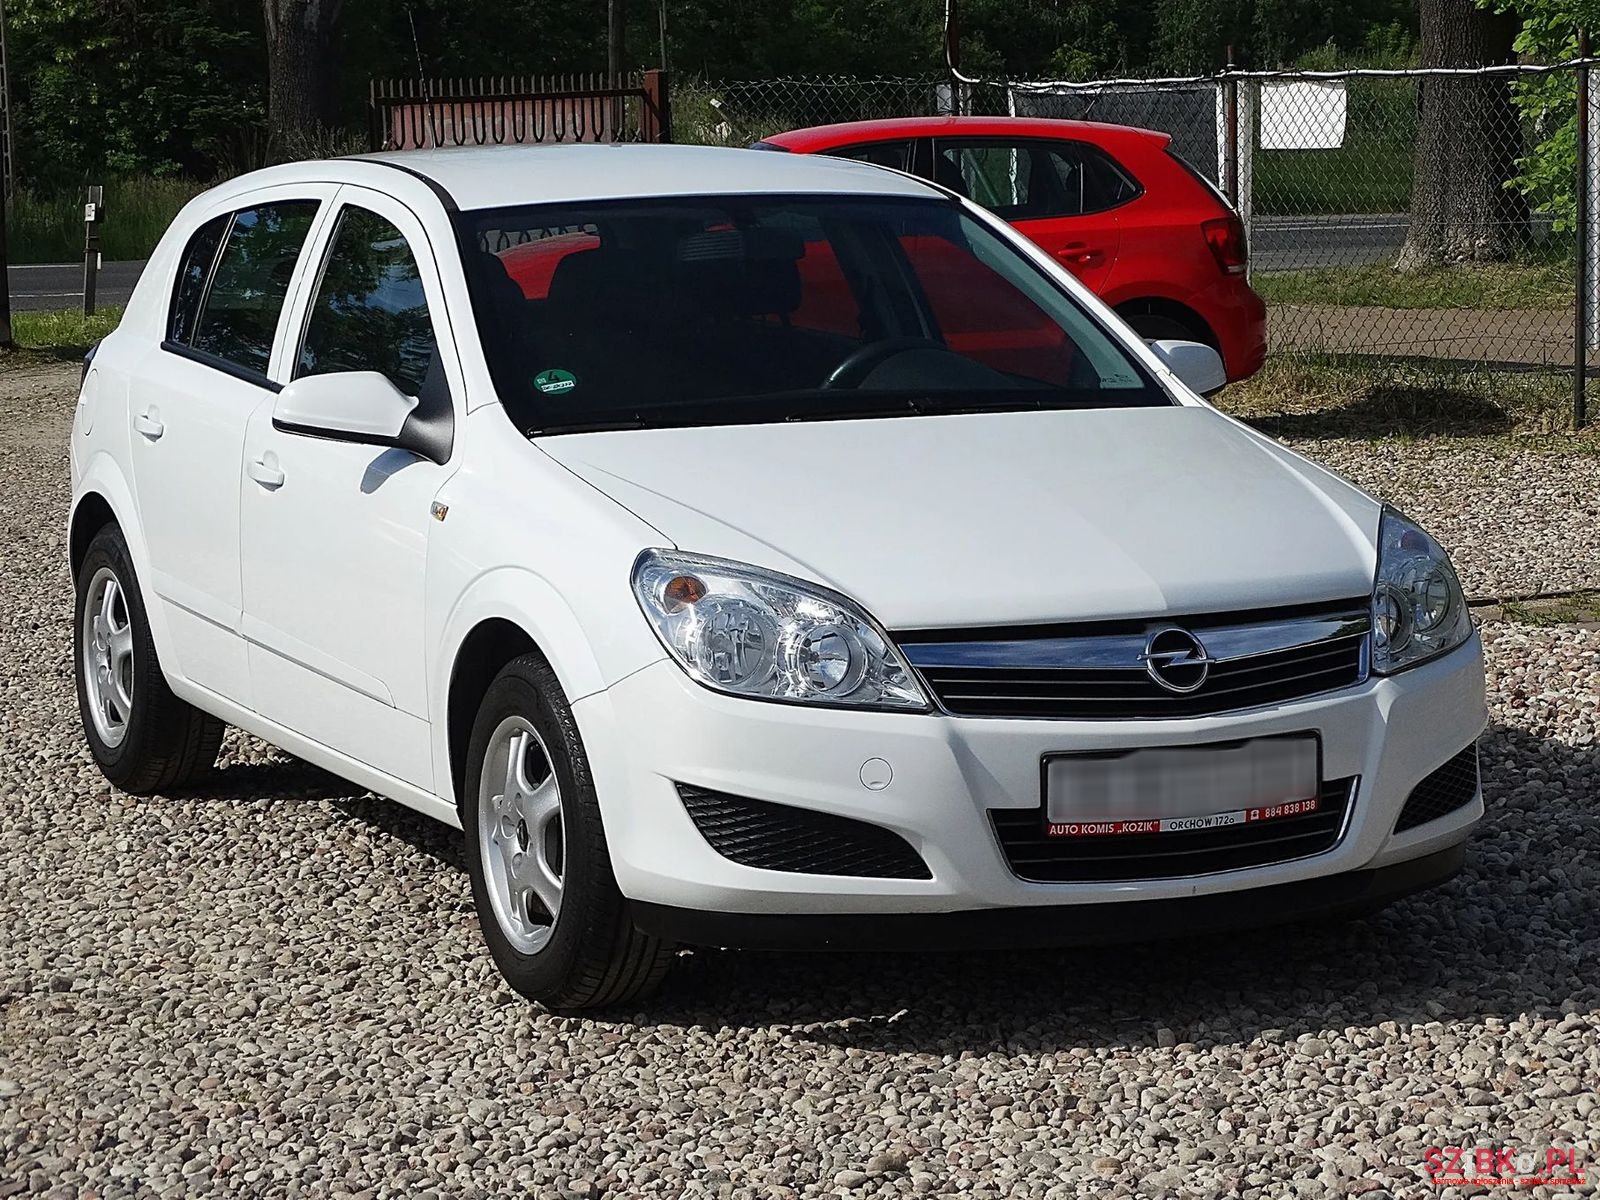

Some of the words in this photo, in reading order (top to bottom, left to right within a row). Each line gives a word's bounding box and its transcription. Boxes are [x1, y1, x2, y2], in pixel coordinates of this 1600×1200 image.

[1049, 824, 1079, 835] AUTO
[1081, 823, 1115, 834] KOMIS
[1169, 817, 1213, 830] ORCHOW
[1265, 806, 1282, 818] 884
[1284, 803, 1300, 815] 838
[1302, 800, 1316, 811] 138
